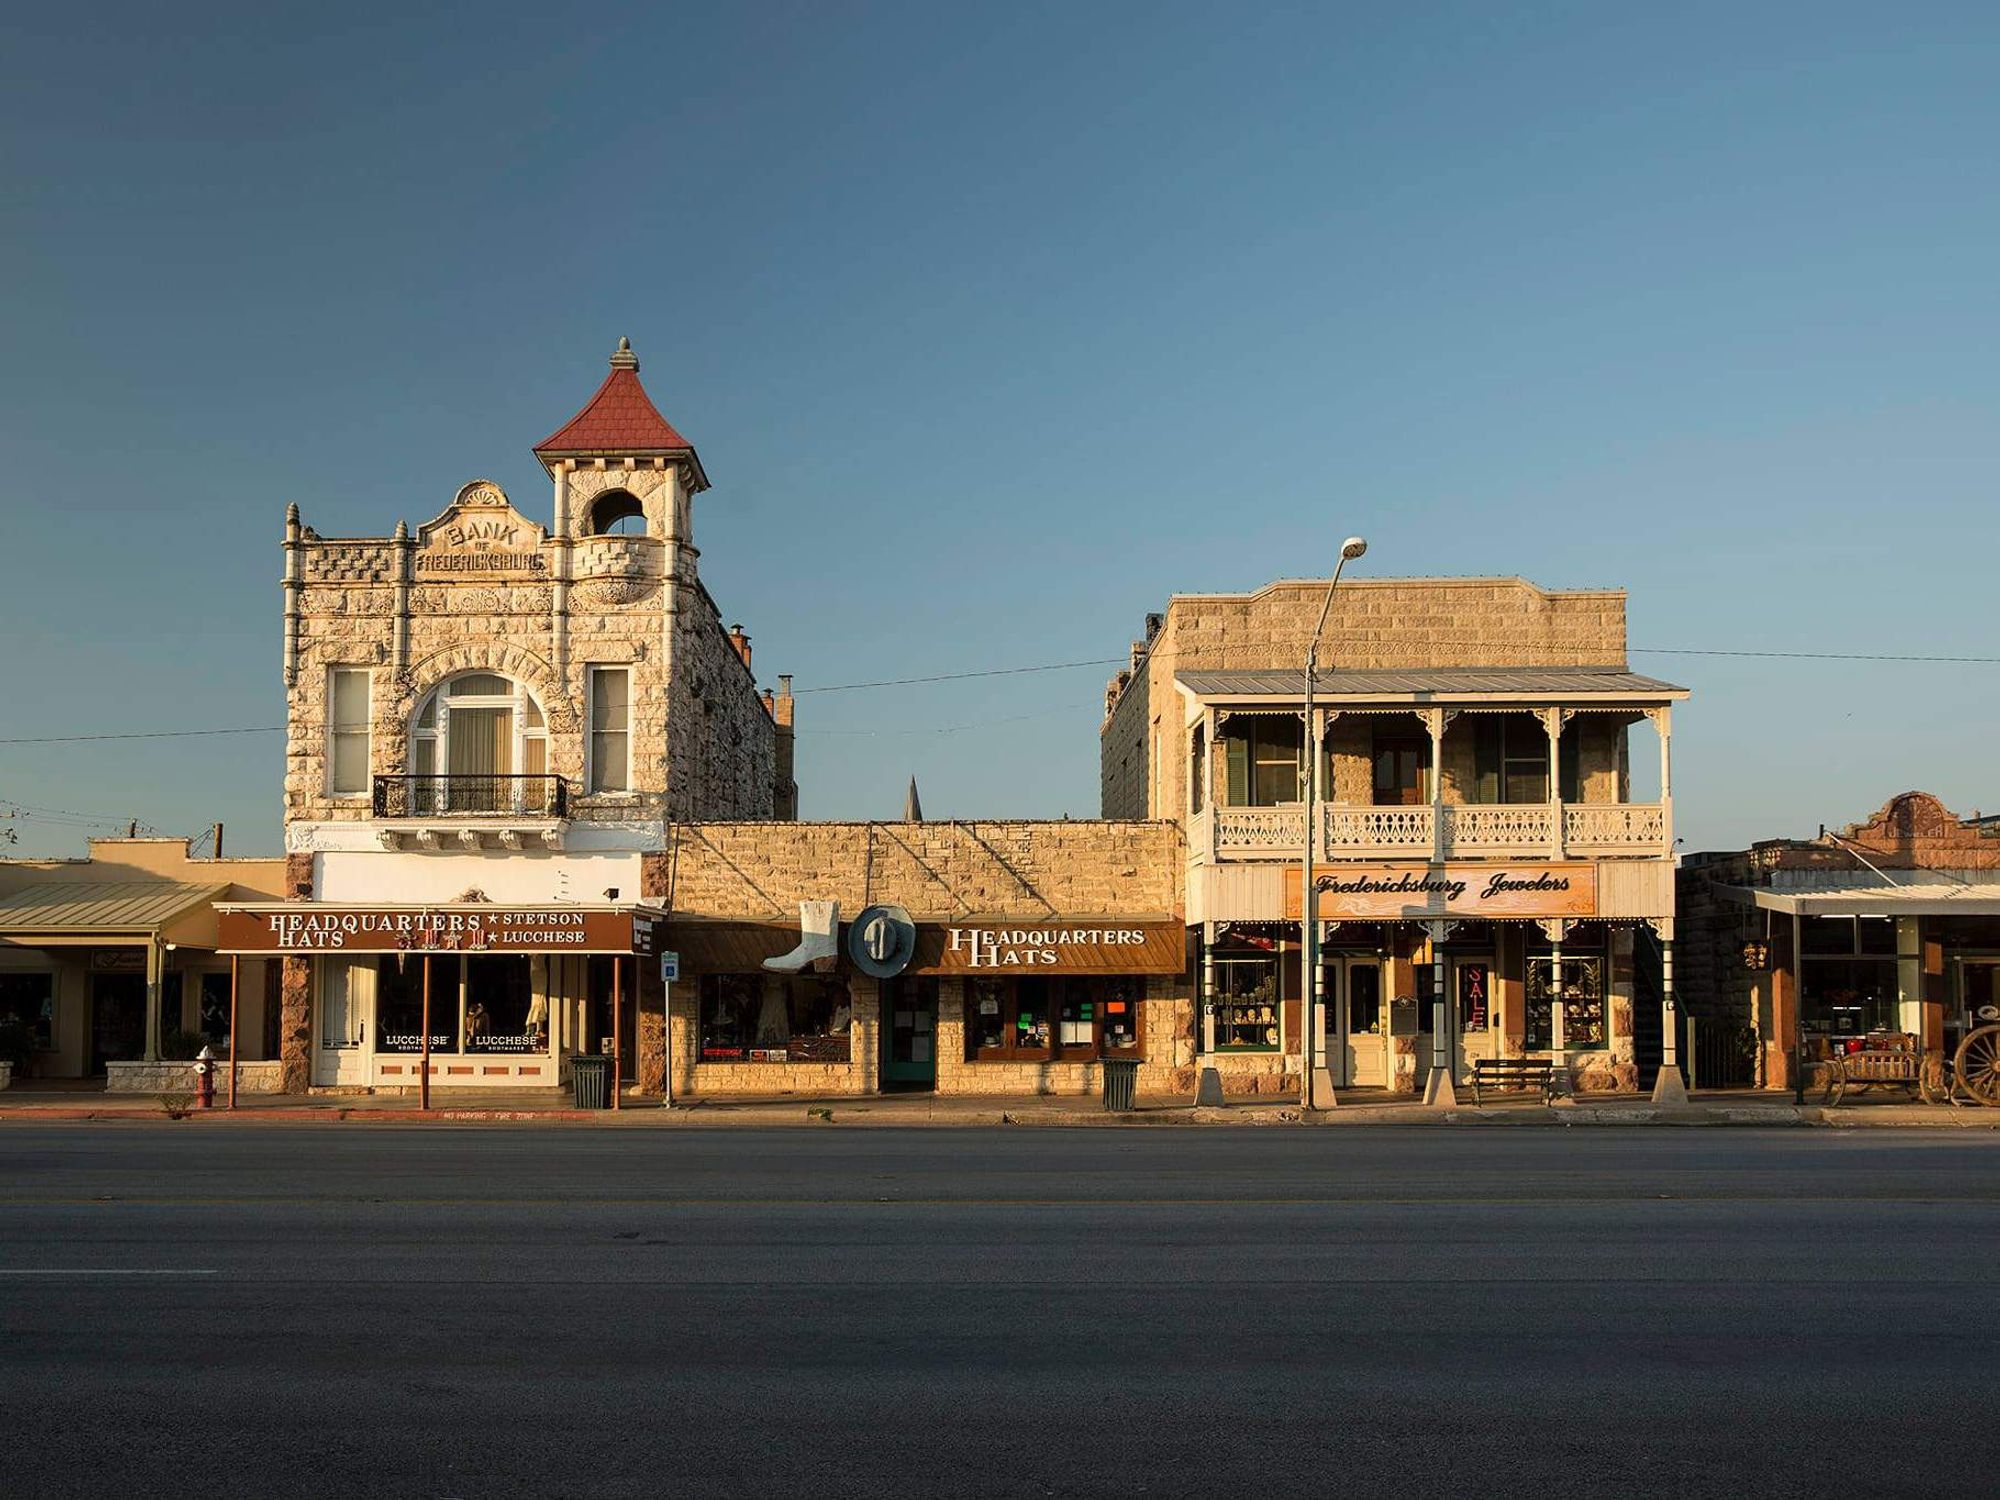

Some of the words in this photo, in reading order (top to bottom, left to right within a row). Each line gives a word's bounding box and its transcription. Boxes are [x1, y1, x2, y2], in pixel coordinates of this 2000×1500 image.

[446, 522, 518, 546] BANK
[1316, 872, 1467, 900] Fredericksburg
[1480, 871, 1570, 899] Jewelers
[268, 914, 481, 933] HEADQUARTERS
[502, 913, 585, 925] STETSON
[277, 930, 345, 948] HATS
[503, 932, 586, 944] LUCCHESE
[949, 928, 1145, 951] HEADQUARTERS
[967, 945, 1058, 967] HATS
[1469, 968, 1485, 1027] SALE
[476, 1036, 537, 1045] LUCCHESE
